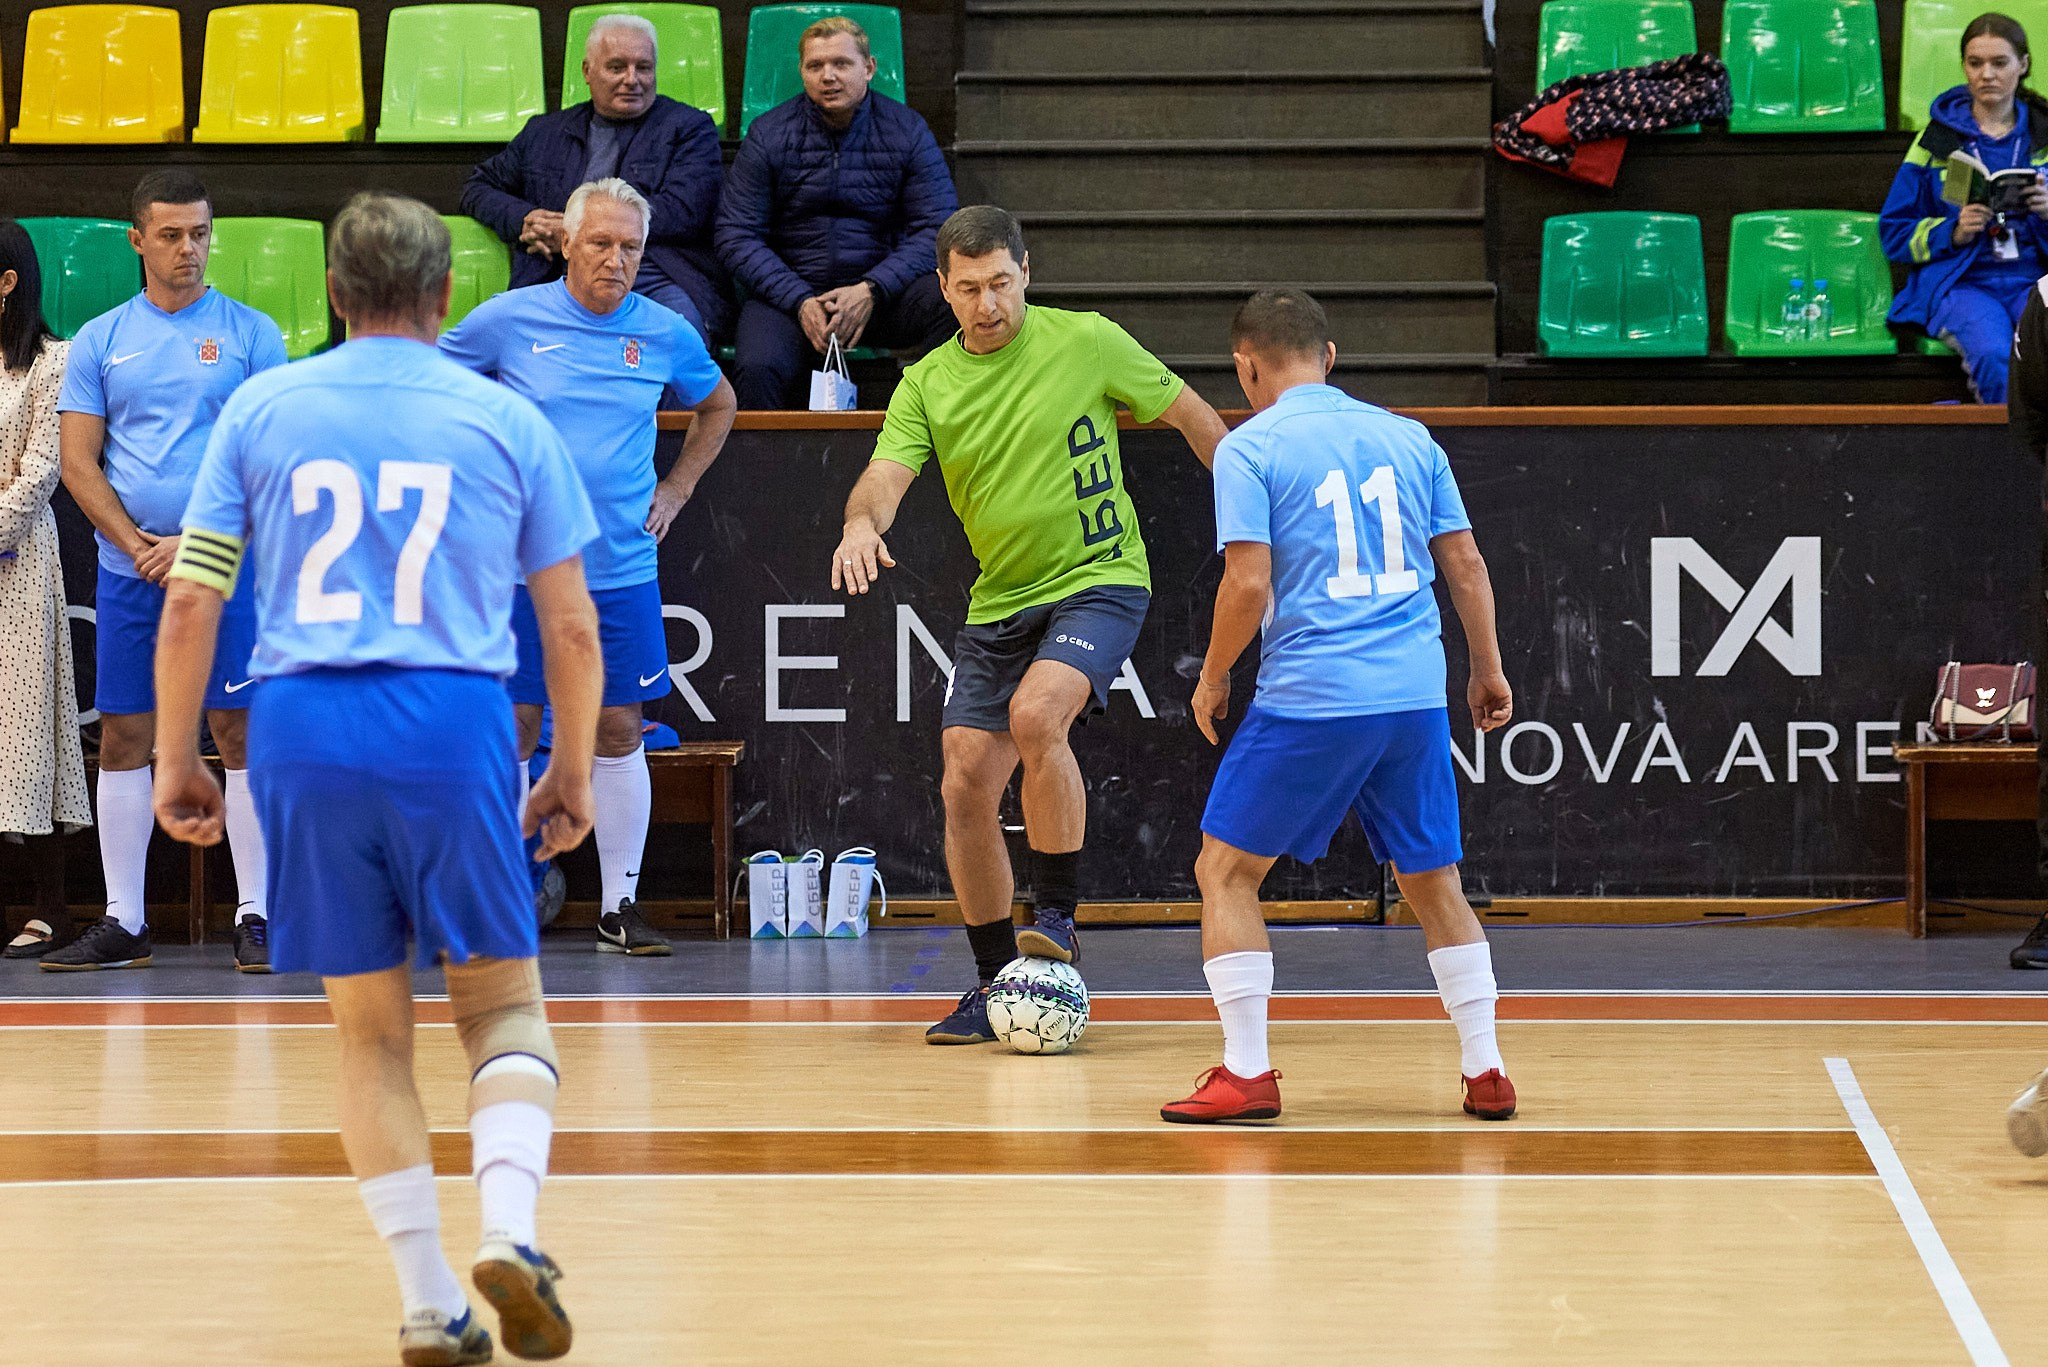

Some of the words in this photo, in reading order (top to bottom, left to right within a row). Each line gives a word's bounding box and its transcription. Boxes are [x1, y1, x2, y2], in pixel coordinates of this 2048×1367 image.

[291, 459, 453, 625] 27
[1314, 465, 1420, 599] 11
[1069, 636, 1095, 651] СБЕР
[1715, 721, 1939, 783] ARE
[772, 868, 785, 917] СБЕР
[807, 867, 821, 917] СБЕР
[848, 869, 861, 918] СБЕР
